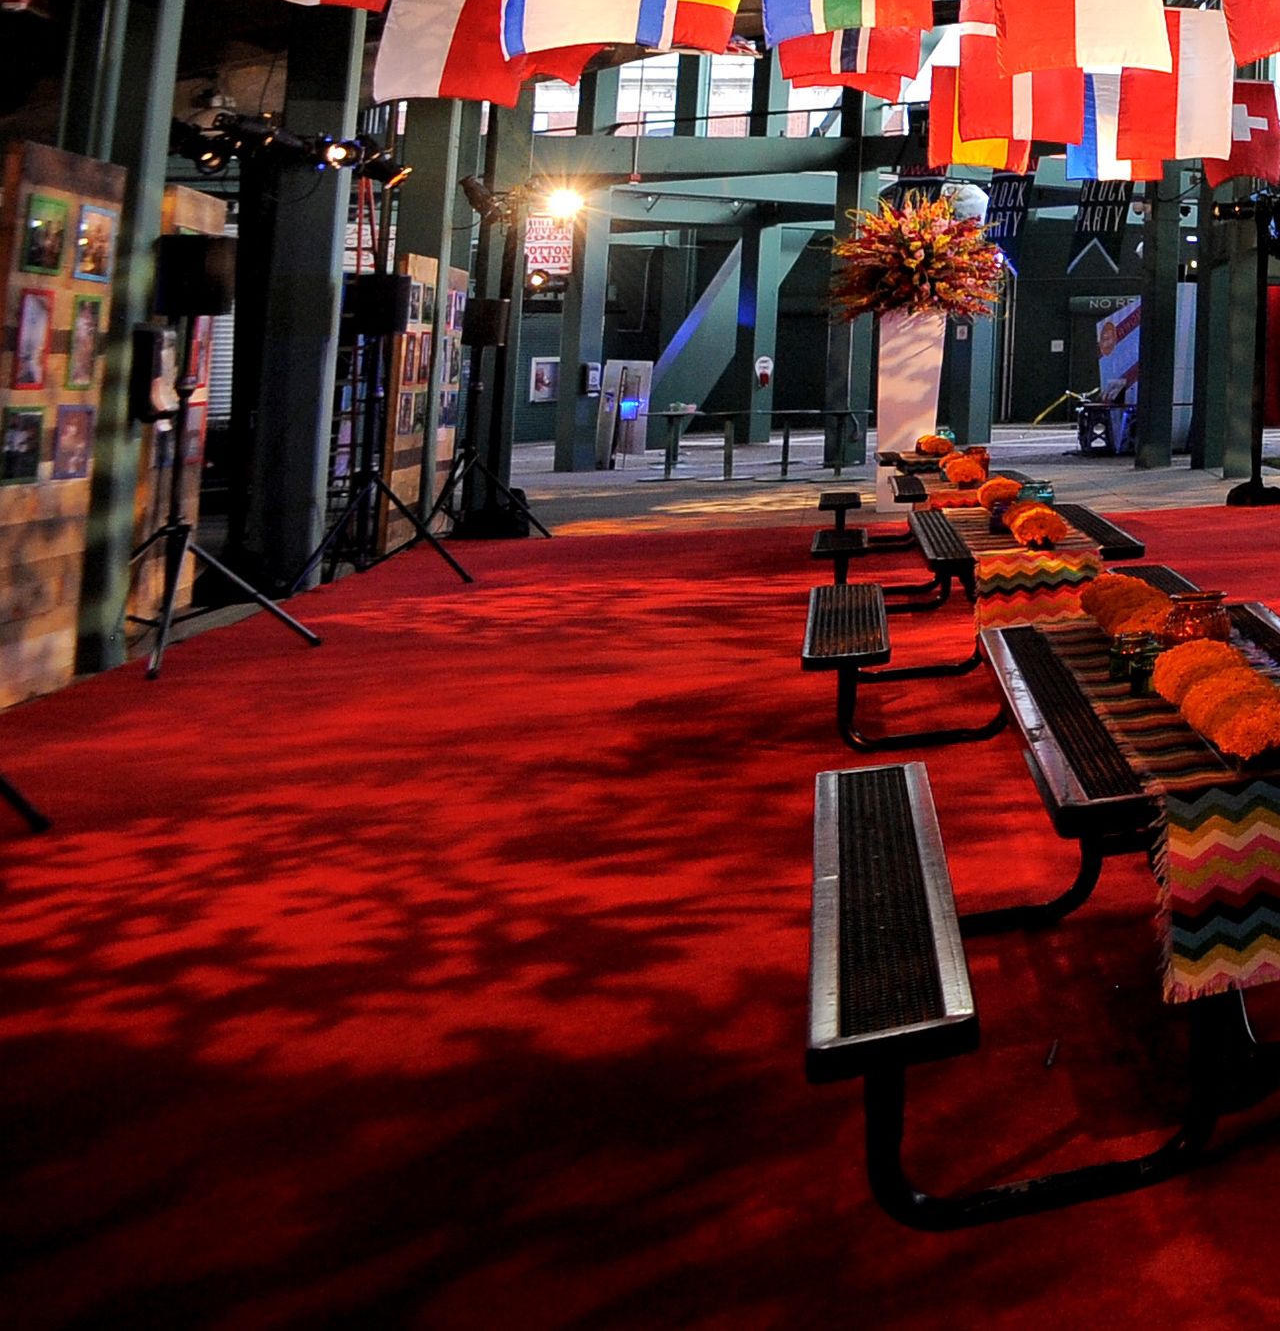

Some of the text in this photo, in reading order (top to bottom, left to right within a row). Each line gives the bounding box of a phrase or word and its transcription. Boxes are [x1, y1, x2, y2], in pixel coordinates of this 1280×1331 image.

[988, 181, 1028, 208] LOCK
[1081, 181, 1127, 202] BLOCK
[986, 210, 1023, 238] ARTY
[1075, 205, 1124, 232] PARTY
